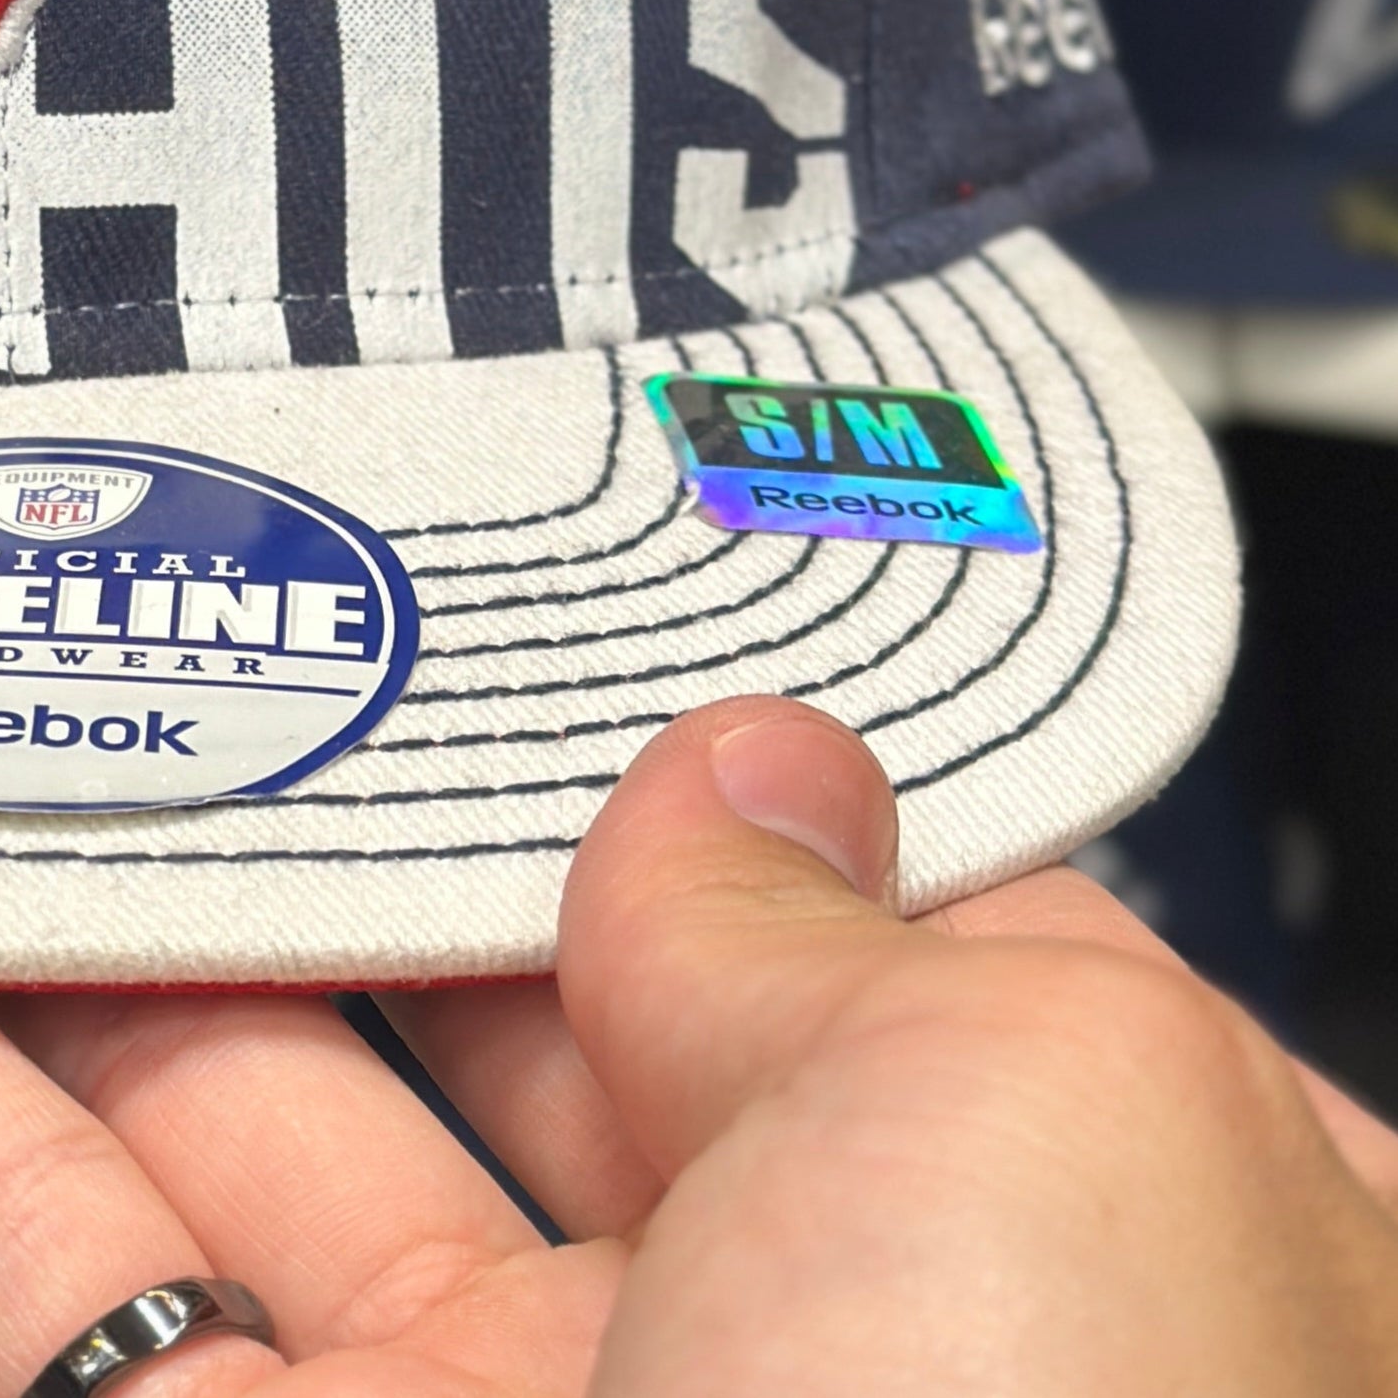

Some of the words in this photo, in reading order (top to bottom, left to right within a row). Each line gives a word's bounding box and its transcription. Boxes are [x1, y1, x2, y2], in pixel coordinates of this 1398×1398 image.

[725, 393, 943, 469] S/M
[23, 504, 89, 525] NFL
[750, 485, 983, 525] Reebok
